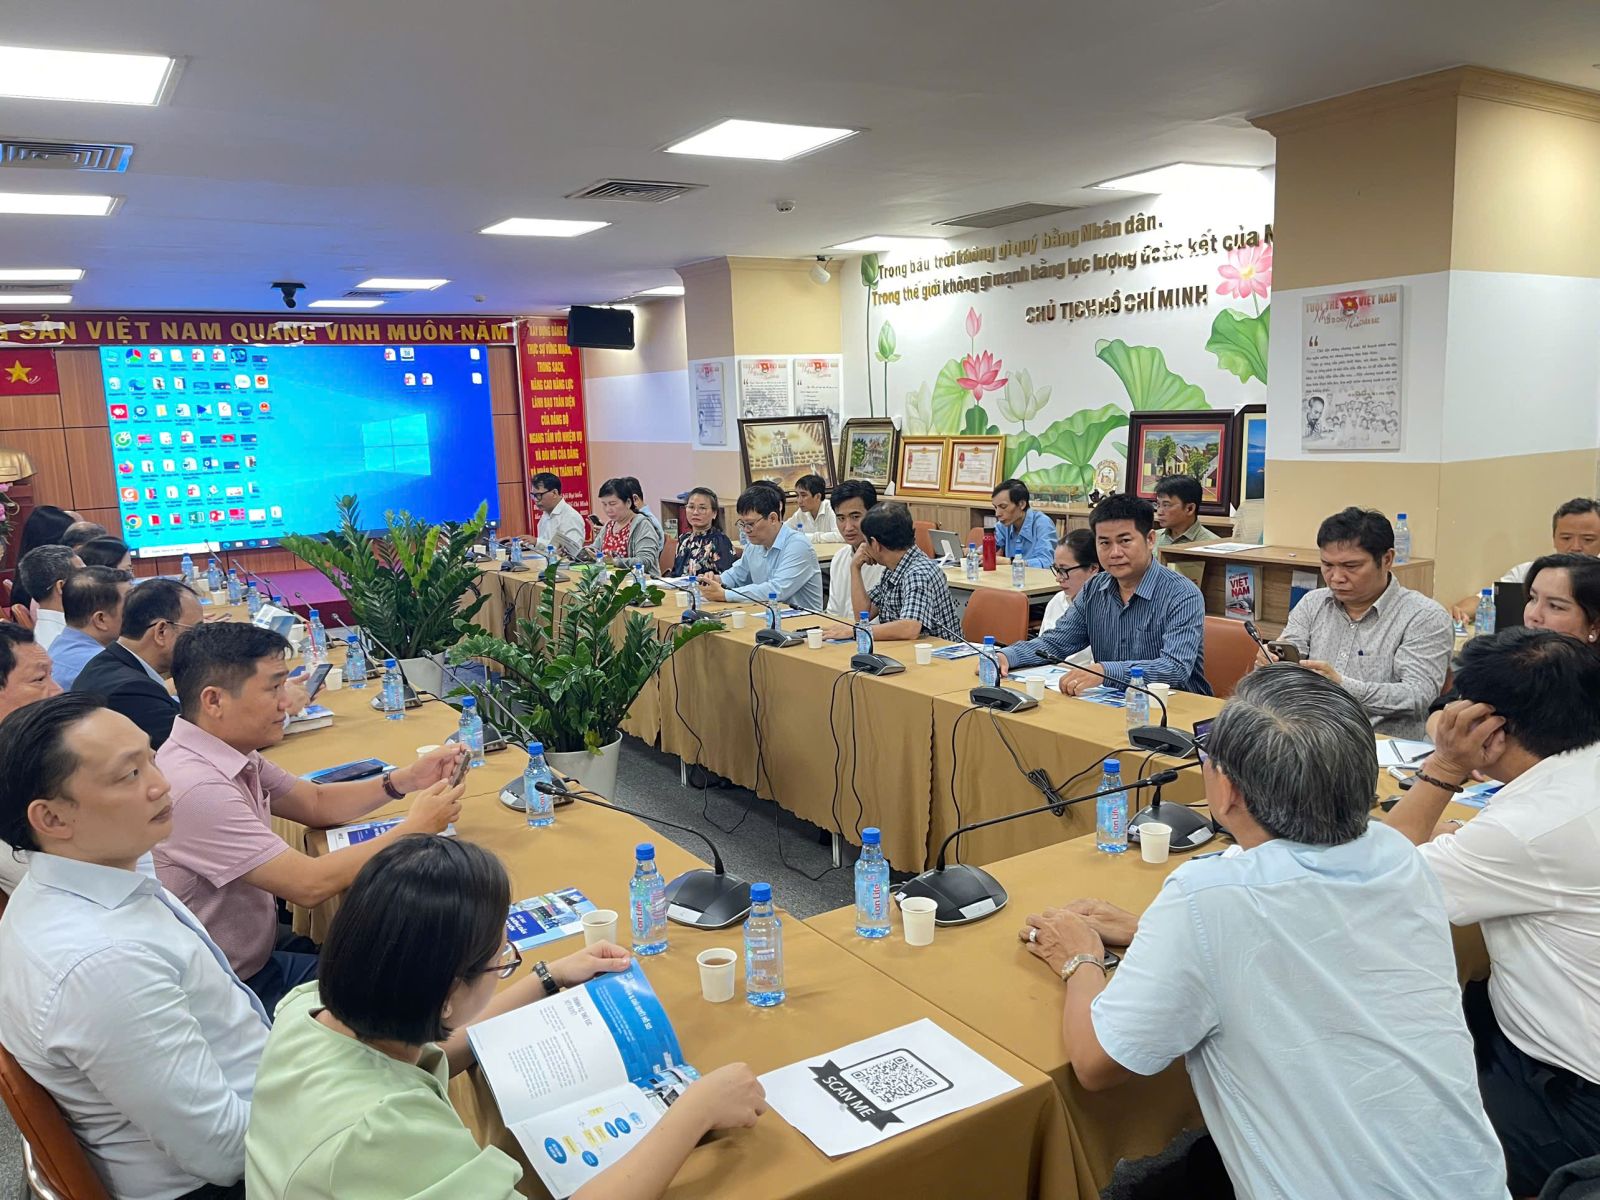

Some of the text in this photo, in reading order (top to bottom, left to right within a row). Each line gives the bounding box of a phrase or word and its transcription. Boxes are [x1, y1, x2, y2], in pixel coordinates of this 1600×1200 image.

[871, 290, 901, 306] Trong
[942, 275, 980, 297] không
[980, 272, 993, 292] gì
[993, 266, 1031, 291] mạnh
[1031, 258, 1067, 281] bằng
[1067, 257, 1091, 279] lực
[1093, 250, 1137, 276] lượng
[1222, 224, 1260, 252] của
[877, 264, 908, 280] Trong
[1011, 234, 1038, 258] quý
[1041, 227, 1080, 250] bằng
[1081, 218, 1122, 242] Nhân
[1124, 212, 1164, 235] dân.
[1025, 298, 1057, 325] CHỦ
[1059, 298, 1097, 323] TỊCH
[1124, 287, 1155, 314] CHÍ
[1157, 284, 1208, 310] MINH
[19, 313, 77, 341] SẢN
[85, 315, 151, 344] VIỆT
[161, 321, 223, 341] NAM
[230, 321, 317, 342] QUANG
[325, 322, 381, 342] VINH
[387, 319, 454, 341] MUÔN
[460, 320, 509, 341] NĂM
[1231, 586, 1250, 598] NAM
[821, 1074, 876, 1119] SCAN ME
